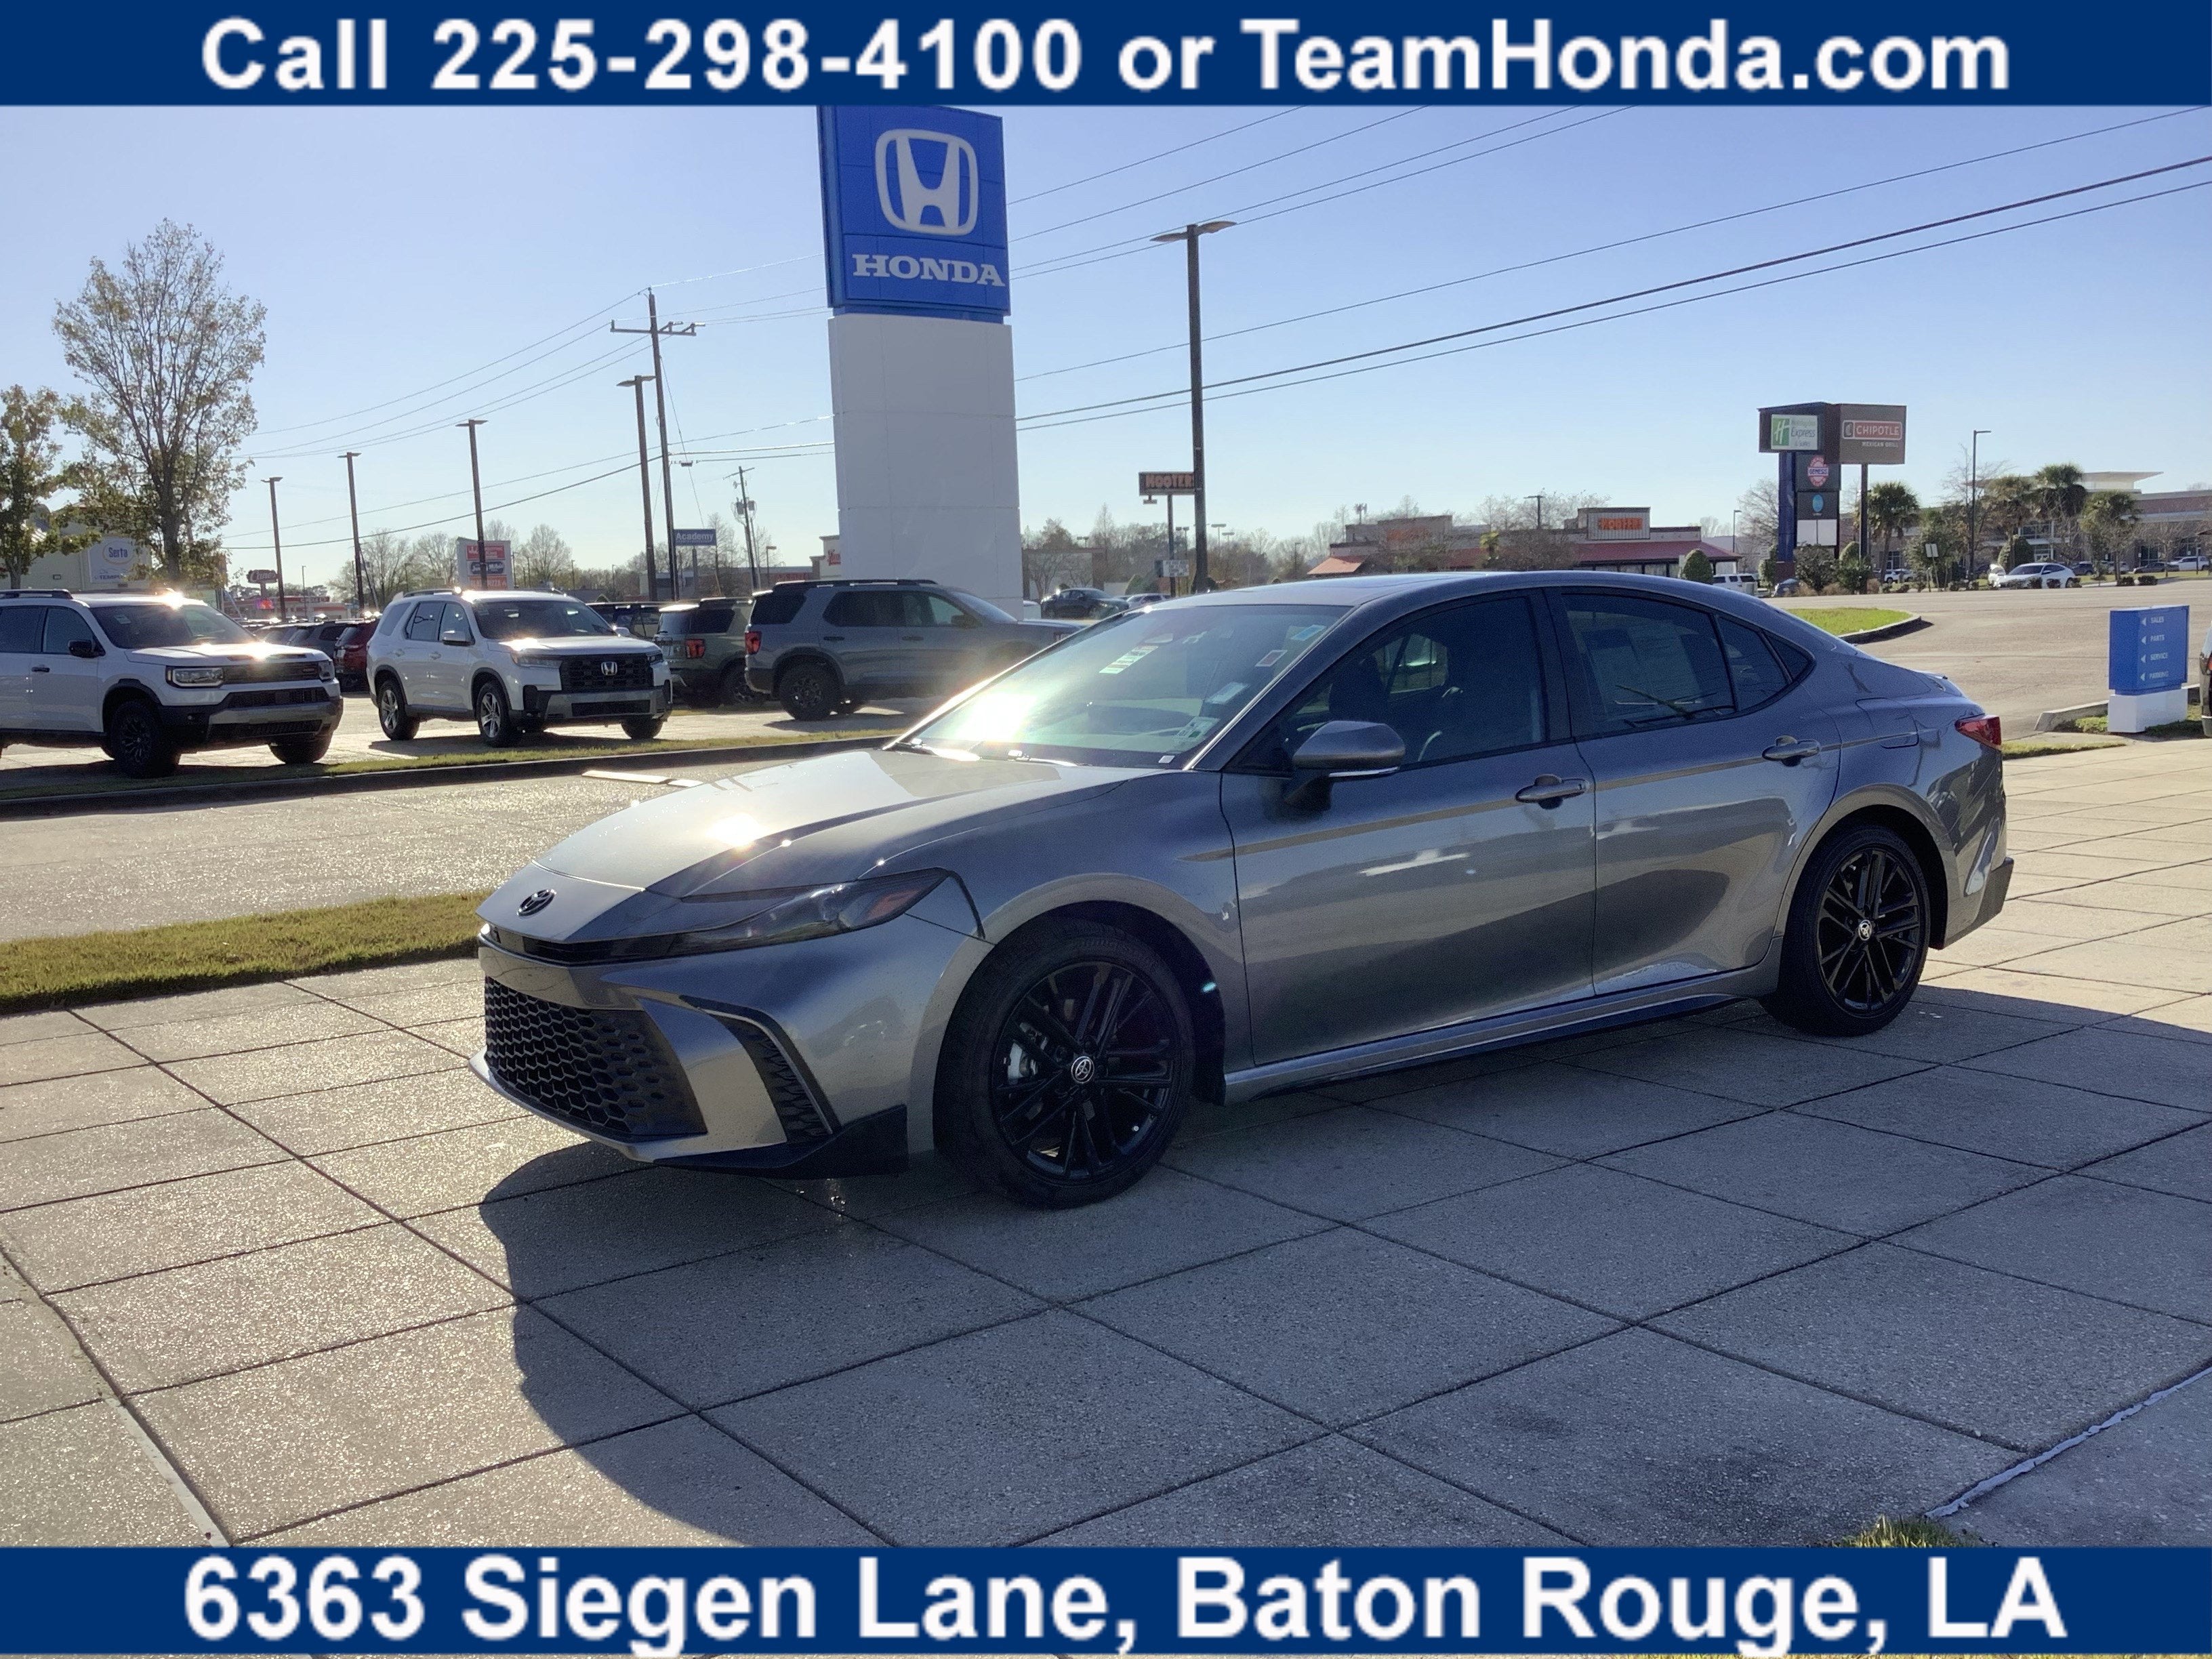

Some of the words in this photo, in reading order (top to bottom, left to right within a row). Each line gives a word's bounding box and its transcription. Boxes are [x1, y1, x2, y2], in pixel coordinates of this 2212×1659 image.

[852, 253, 1006, 287] HONDA
[1790, 426, 1816, 439] Express
[1856, 425, 1900, 435] CHIPOTLE
[676, 532, 714, 541] Academy
[108, 548, 128, 557] Serta
